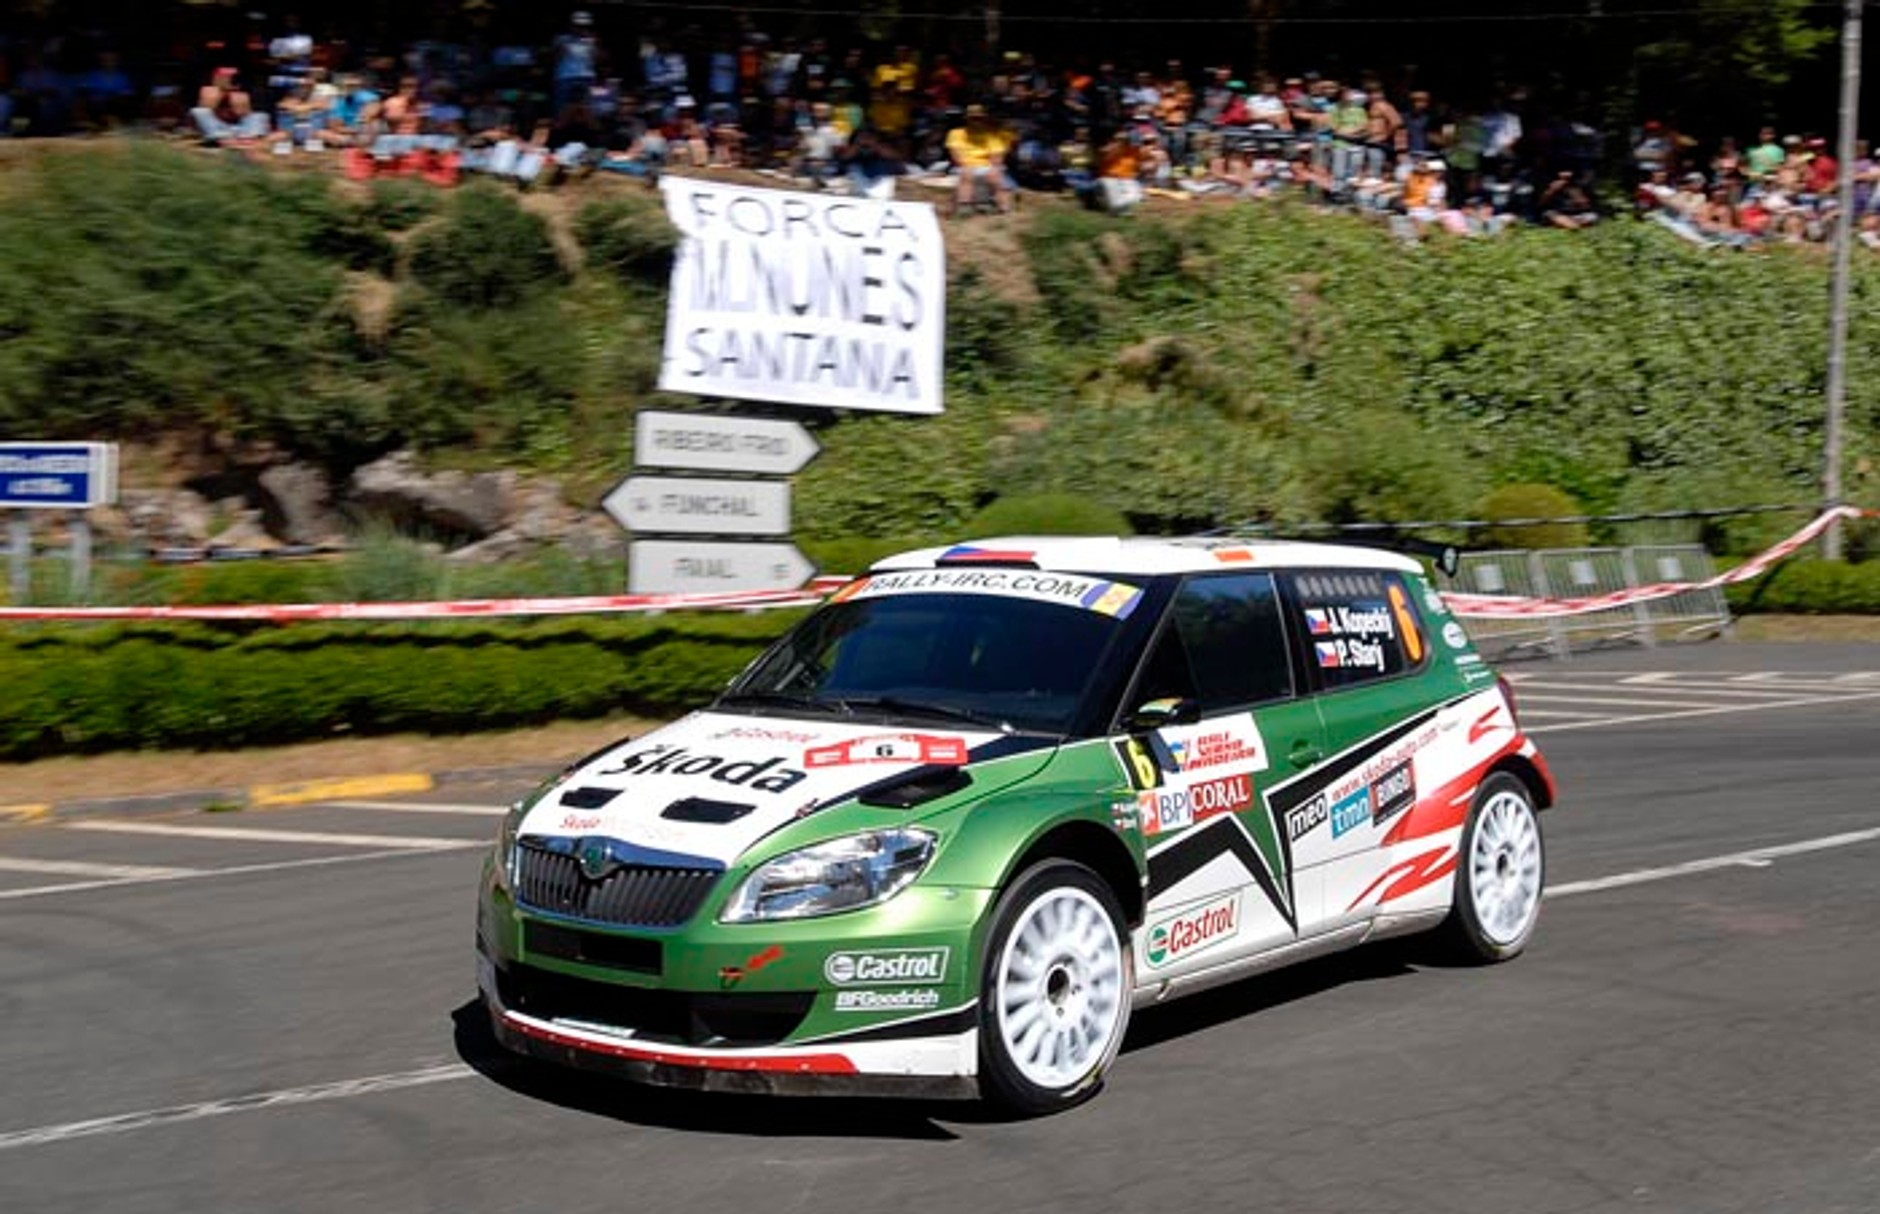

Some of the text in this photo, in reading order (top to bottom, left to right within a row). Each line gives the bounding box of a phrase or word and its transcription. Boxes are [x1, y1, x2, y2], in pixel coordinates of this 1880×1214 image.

[685, 327, 920, 400] SANTANA
[865, 570, 1090, 599] RALLY-IRC.COM
[1388, 583, 1424, 663] 6
[876, 743, 893, 757] 6
[1128, 737, 1156, 790] 6
[1191, 776, 1250, 811] CORAL
[1291, 798, 1327, 835] meo
[1170, 898, 1234, 954] Castrol
[856, 953, 938, 980] Castrol
